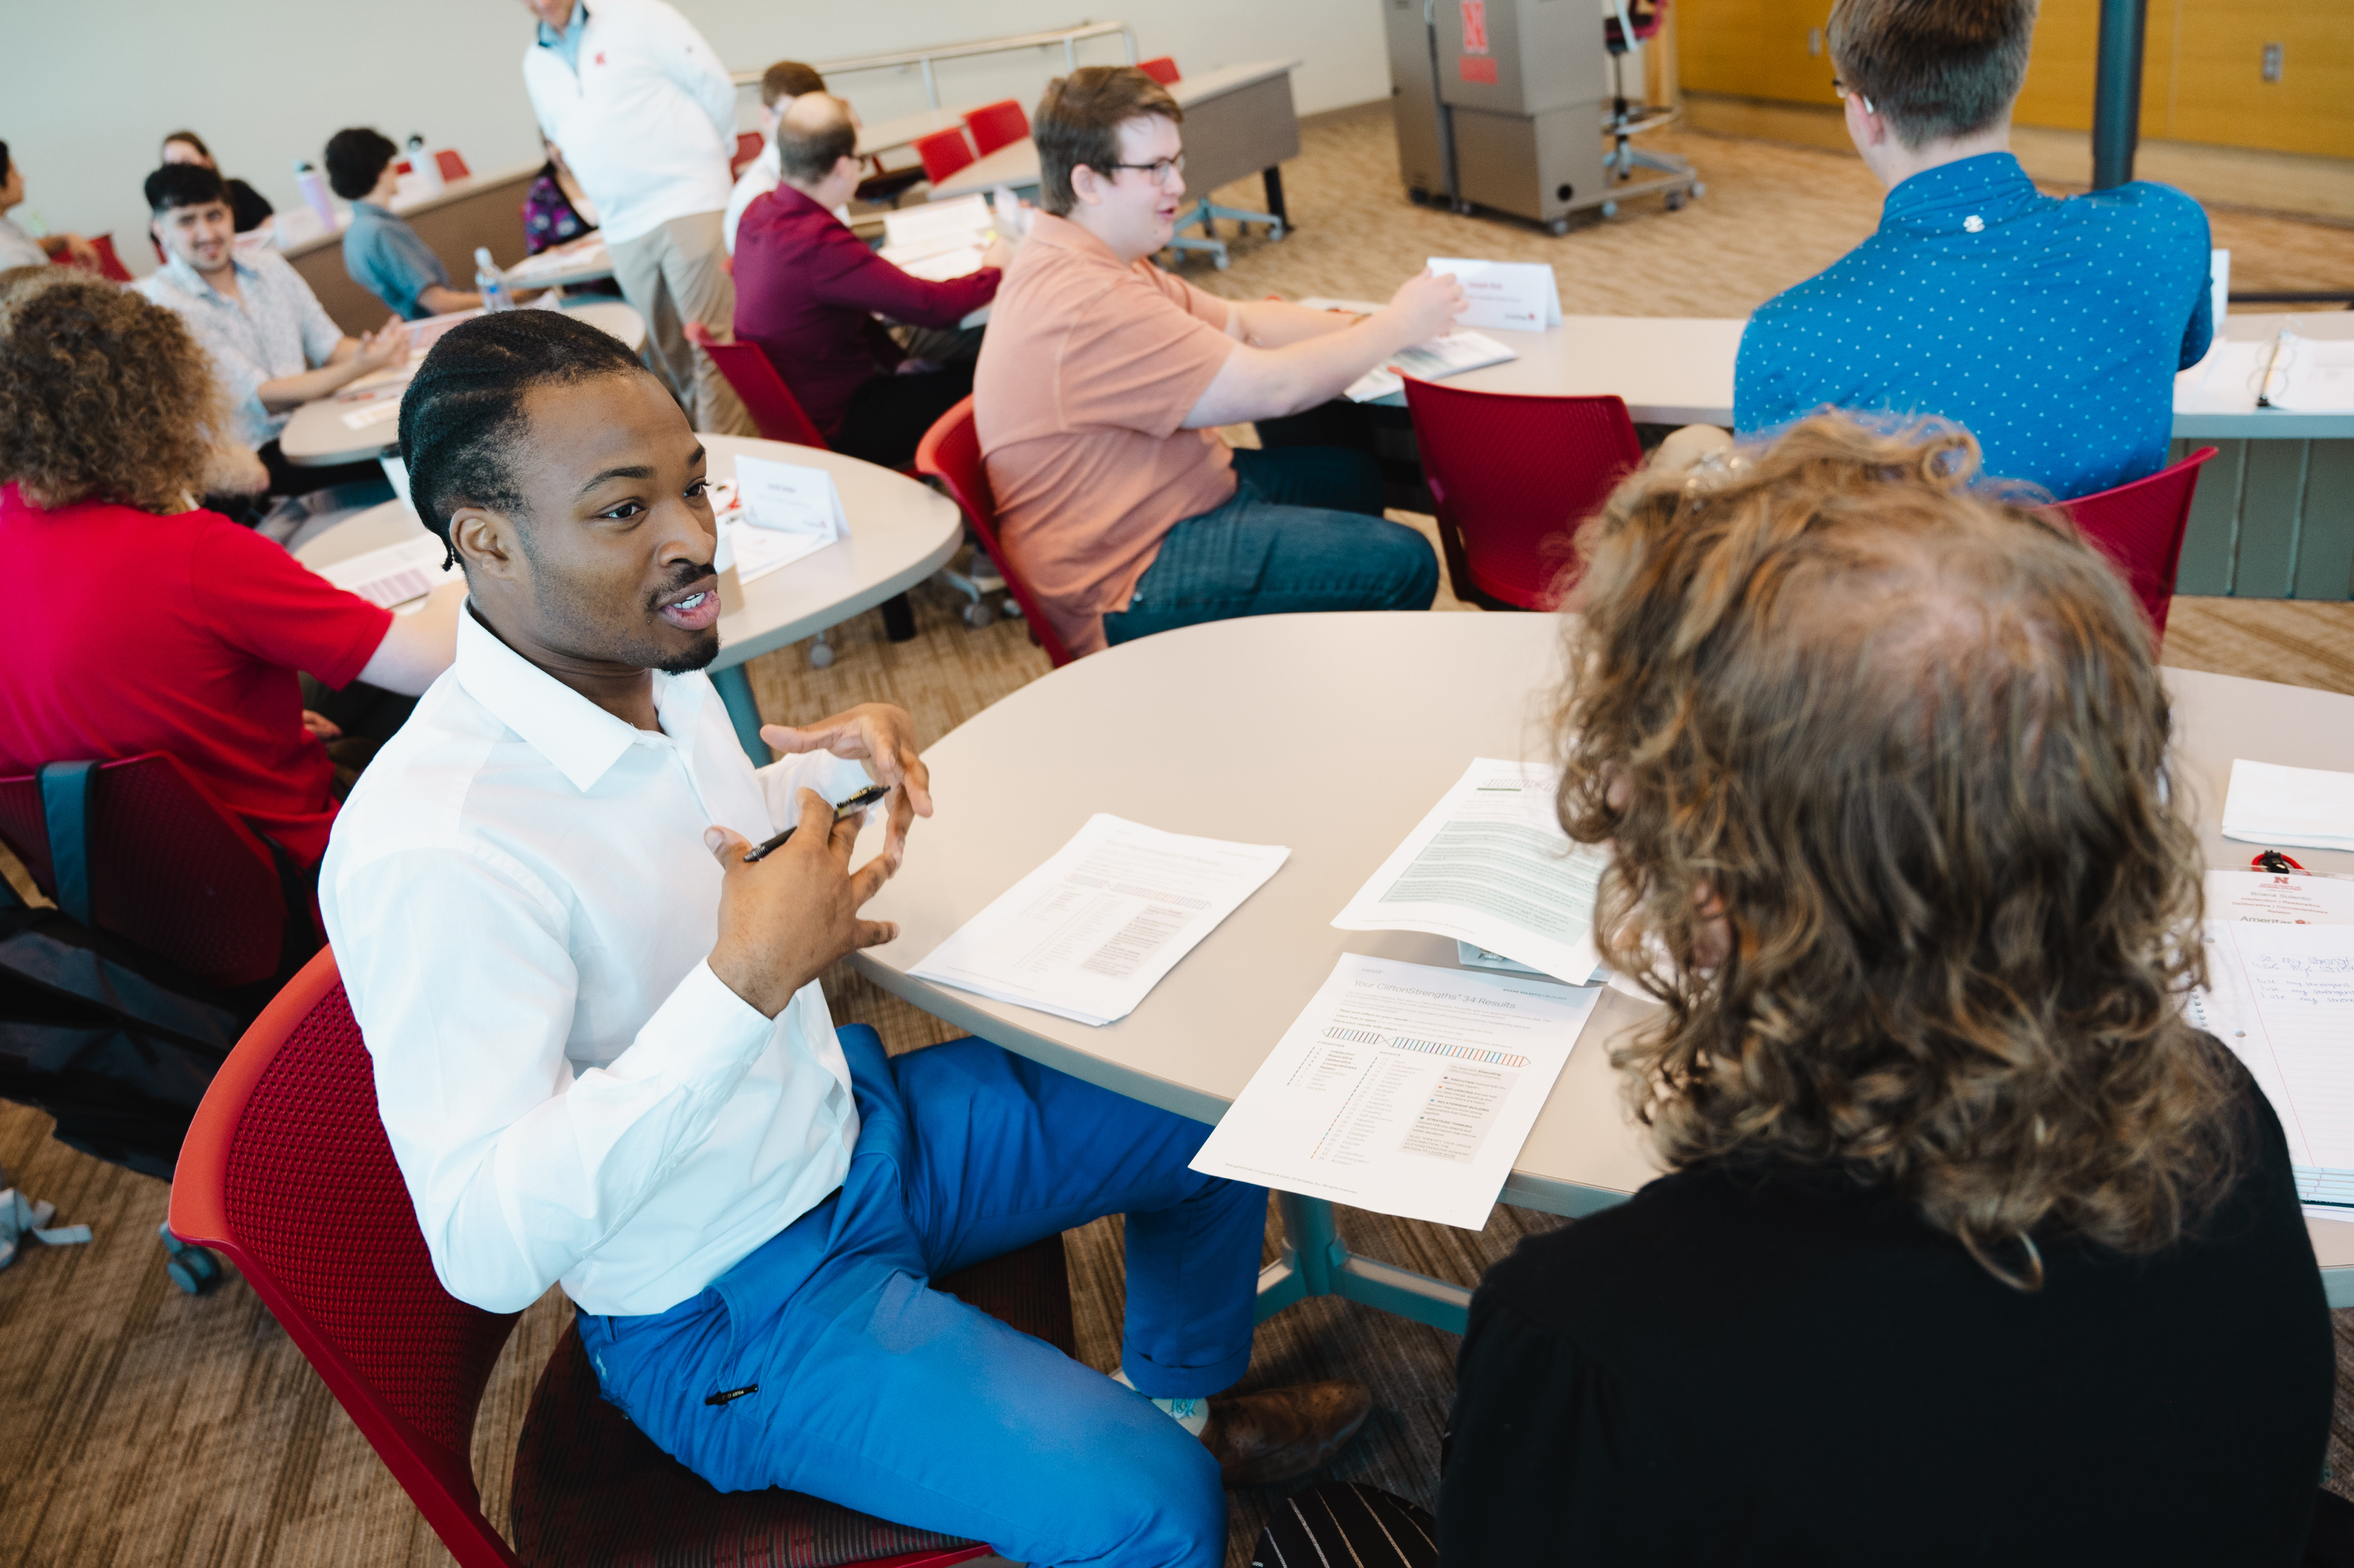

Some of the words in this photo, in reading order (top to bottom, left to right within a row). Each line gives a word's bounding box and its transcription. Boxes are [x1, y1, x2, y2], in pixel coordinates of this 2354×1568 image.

[2277, 905, 2328, 914] Connectedness
[1355, 979, 1375, 988] Your
[1478, 998, 1516, 1009] Results
